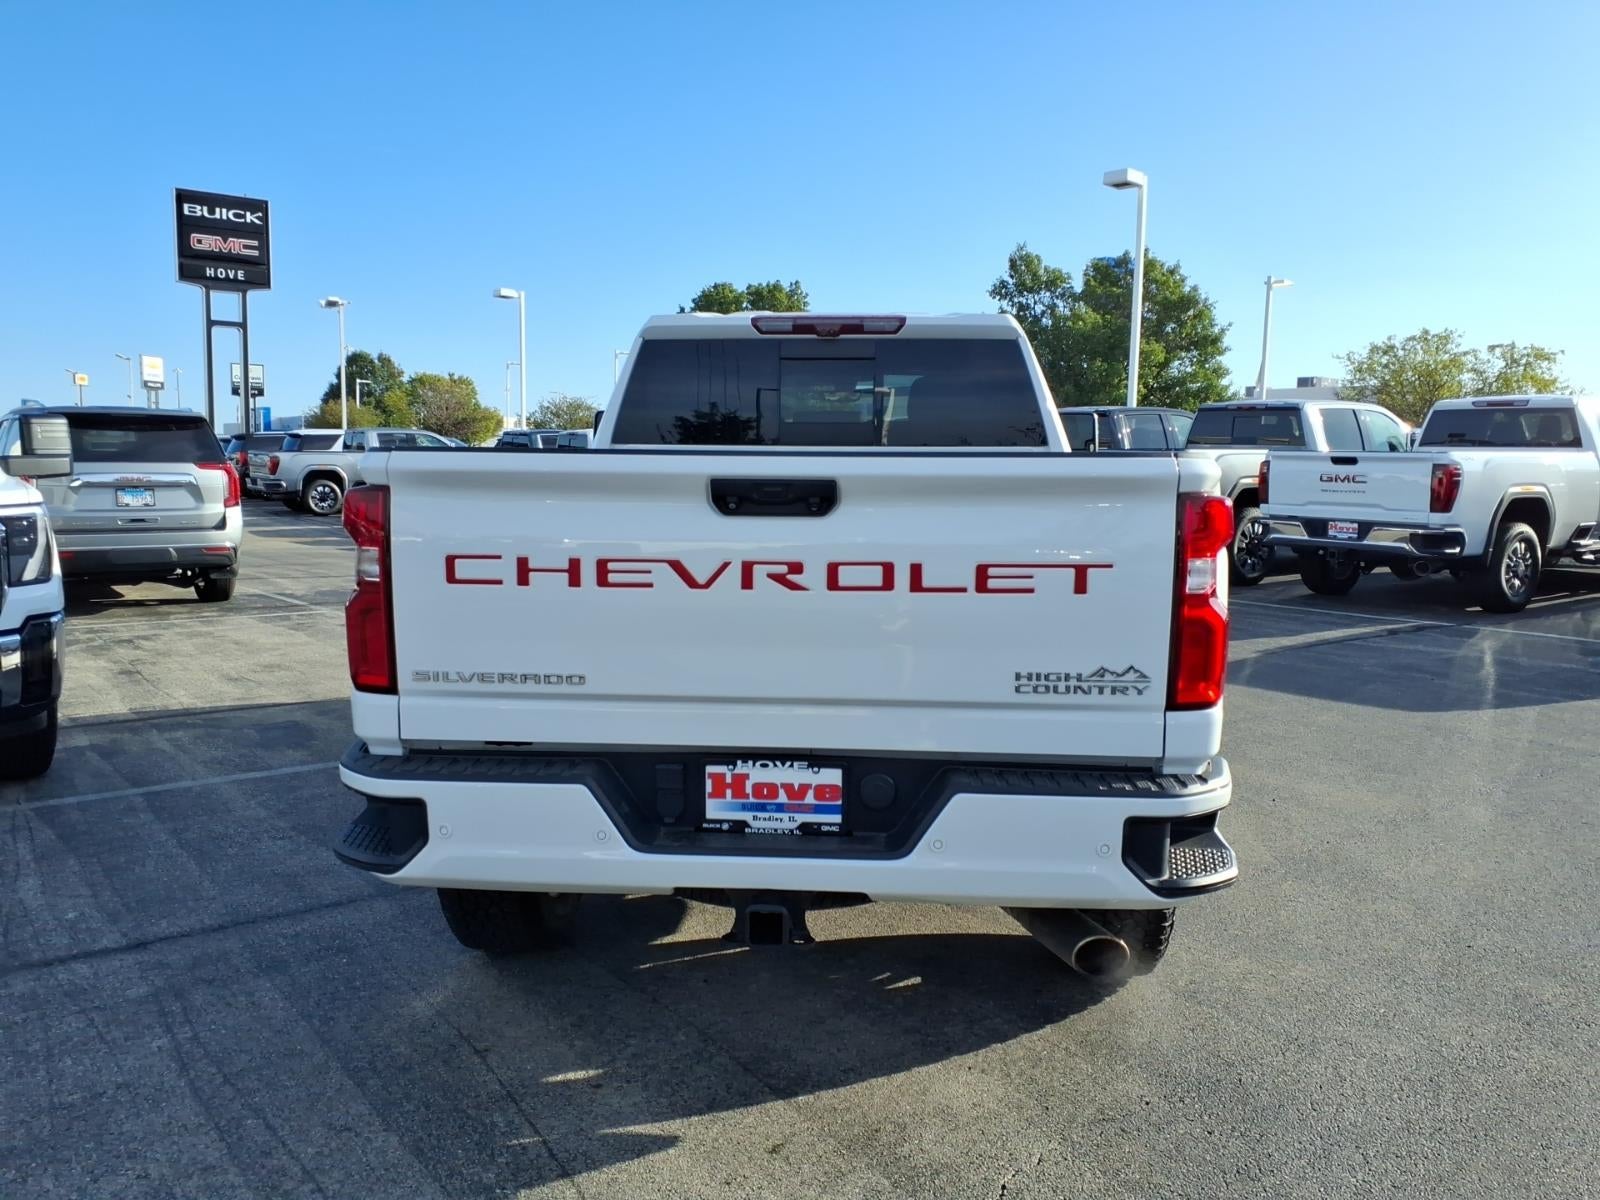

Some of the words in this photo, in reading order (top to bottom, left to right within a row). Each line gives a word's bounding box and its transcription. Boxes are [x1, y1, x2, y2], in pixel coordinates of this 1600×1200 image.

[183, 203, 263, 224] BUICK
[190, 233, 259, 256] GMC
[206, 267, 245, 280] HOVE
[1320, 474, 1368, 484] GMC
[445, 554, 1113, 594] CHEVROLET
[412, 670, 586, 686] SILVERADO
[1014, 672, 1084, 682] HIGH
[1014, 684, 1151, 696] COUNTRY
[736, 759, 809, 772] HOVE
[707, 772, 842, 803] Hove
